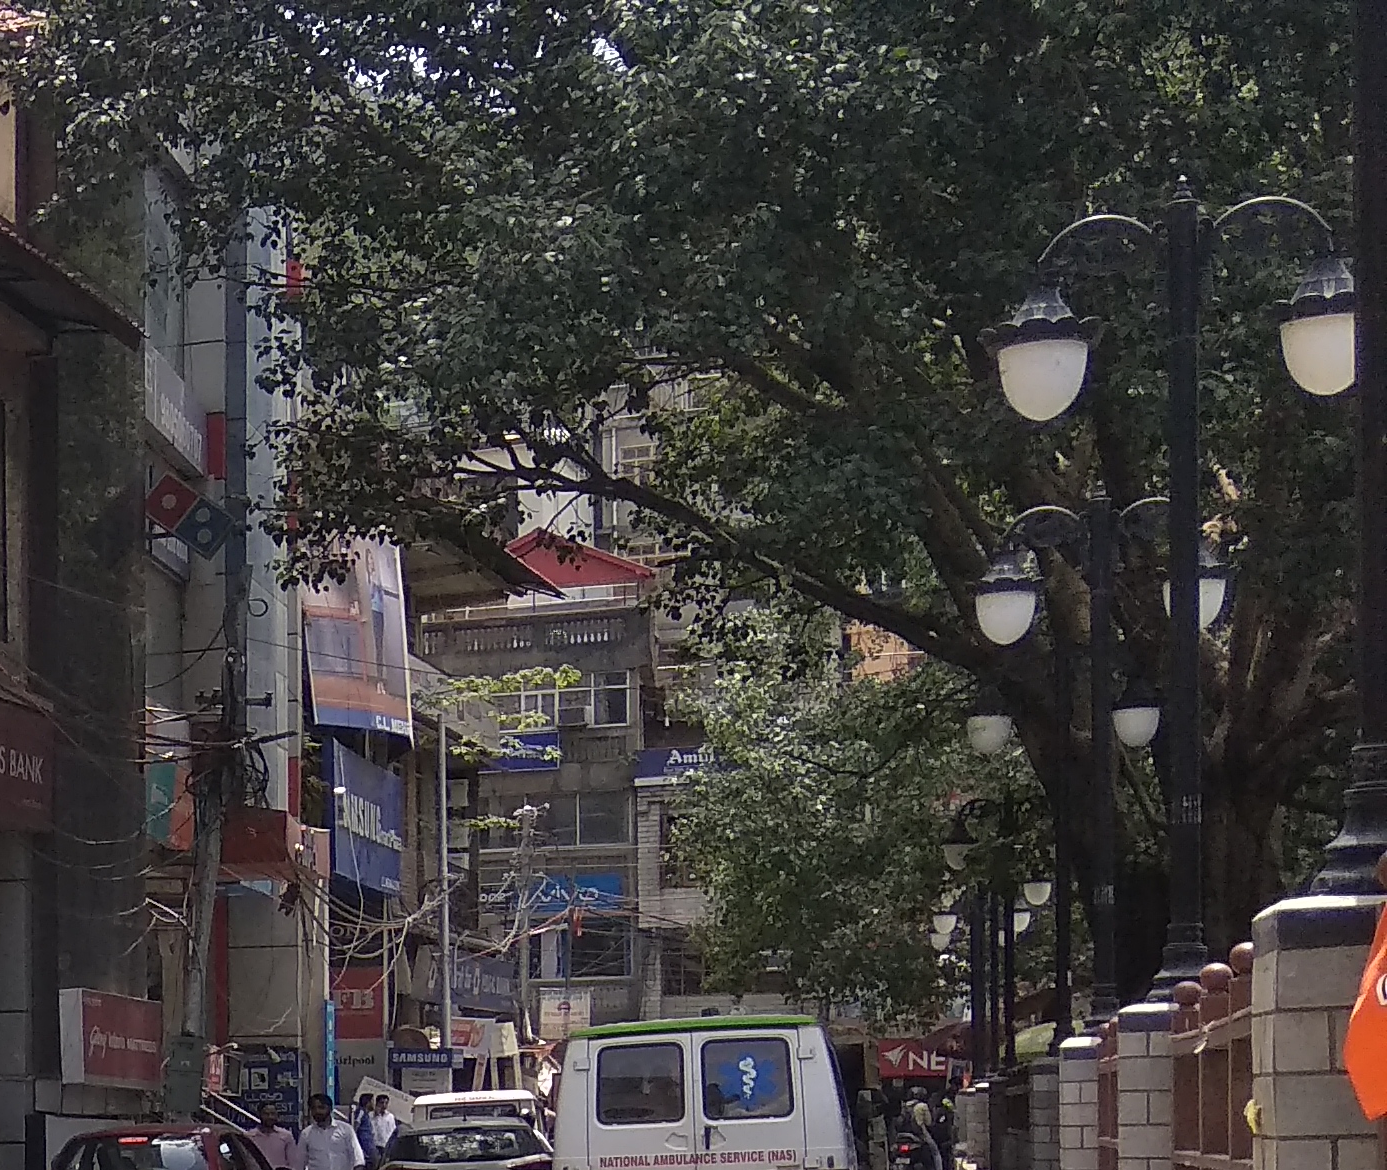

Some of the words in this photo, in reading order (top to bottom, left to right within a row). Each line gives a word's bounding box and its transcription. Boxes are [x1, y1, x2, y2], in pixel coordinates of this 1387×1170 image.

[9, 749, 44, 784] BANK
[391, 1053, 449, 1065] SAMSUNG
[599, 1154, 651, 1168] NATIONAL
[653, 1151, 717, 1166] AMBULANCE
[720, 1149, 765, 1163] SERVICE
[767, 1149, 798, 1164] (NAS)
